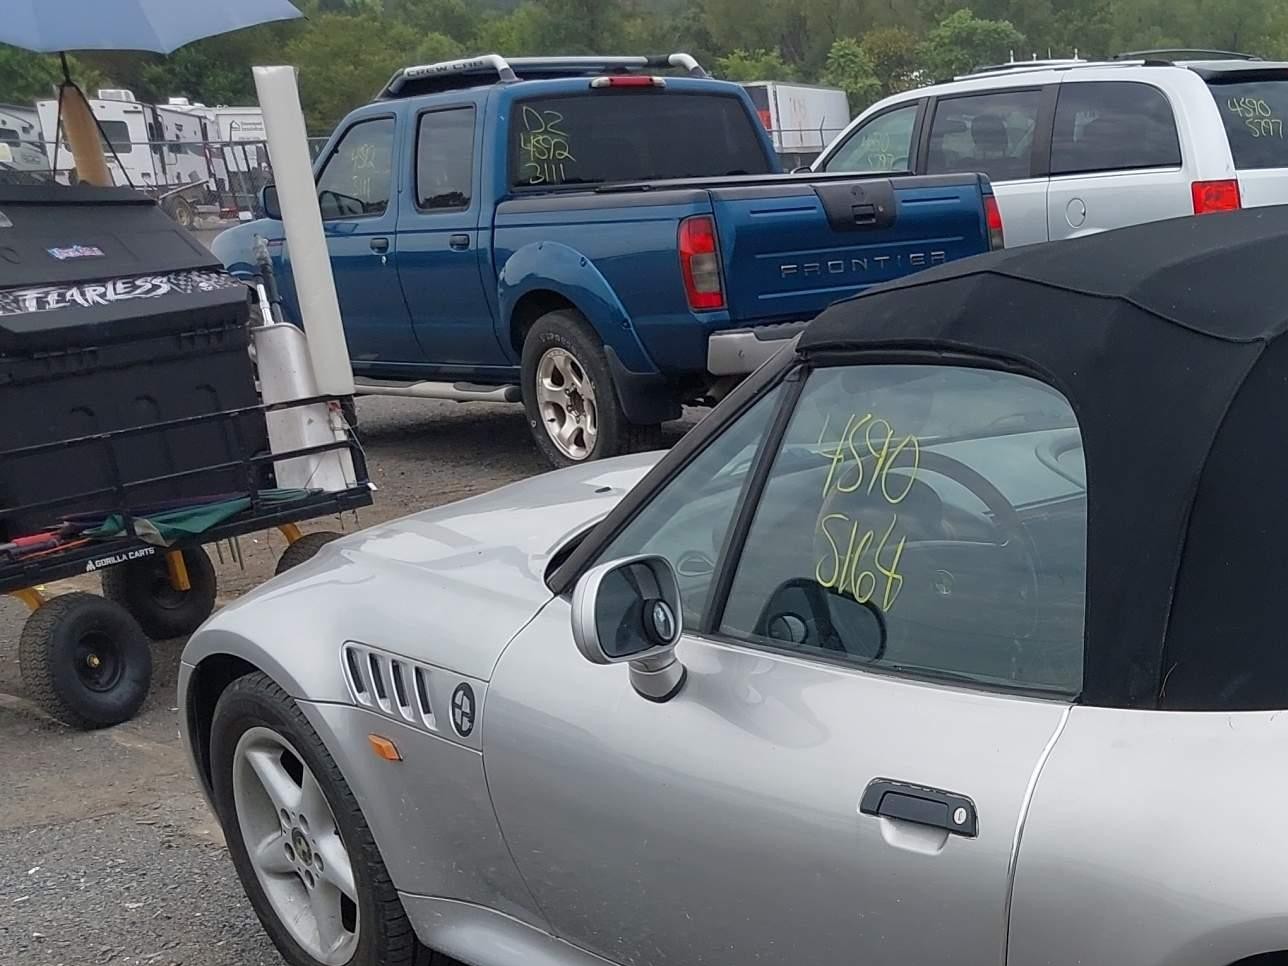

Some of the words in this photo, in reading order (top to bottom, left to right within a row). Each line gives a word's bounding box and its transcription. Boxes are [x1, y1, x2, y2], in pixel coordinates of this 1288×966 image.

[407, 66, 448, 78] CREW
[1227, 97, 1272, 118] 4590
[1245, 118, 1284, 140] 5797
[520, 132, 577, 161] 4592
[524, 162, 566, 185] 3111
[780, 251, 945, 279] FRONTIER
[15, 276, 171, 313] FEARLESS
[814, 413, 920, 503] 4590
[95, 553, 128, 569] GORILLA
[128, 546, 156, 560] CARTS
[815, 513, 907, 612] 5164
